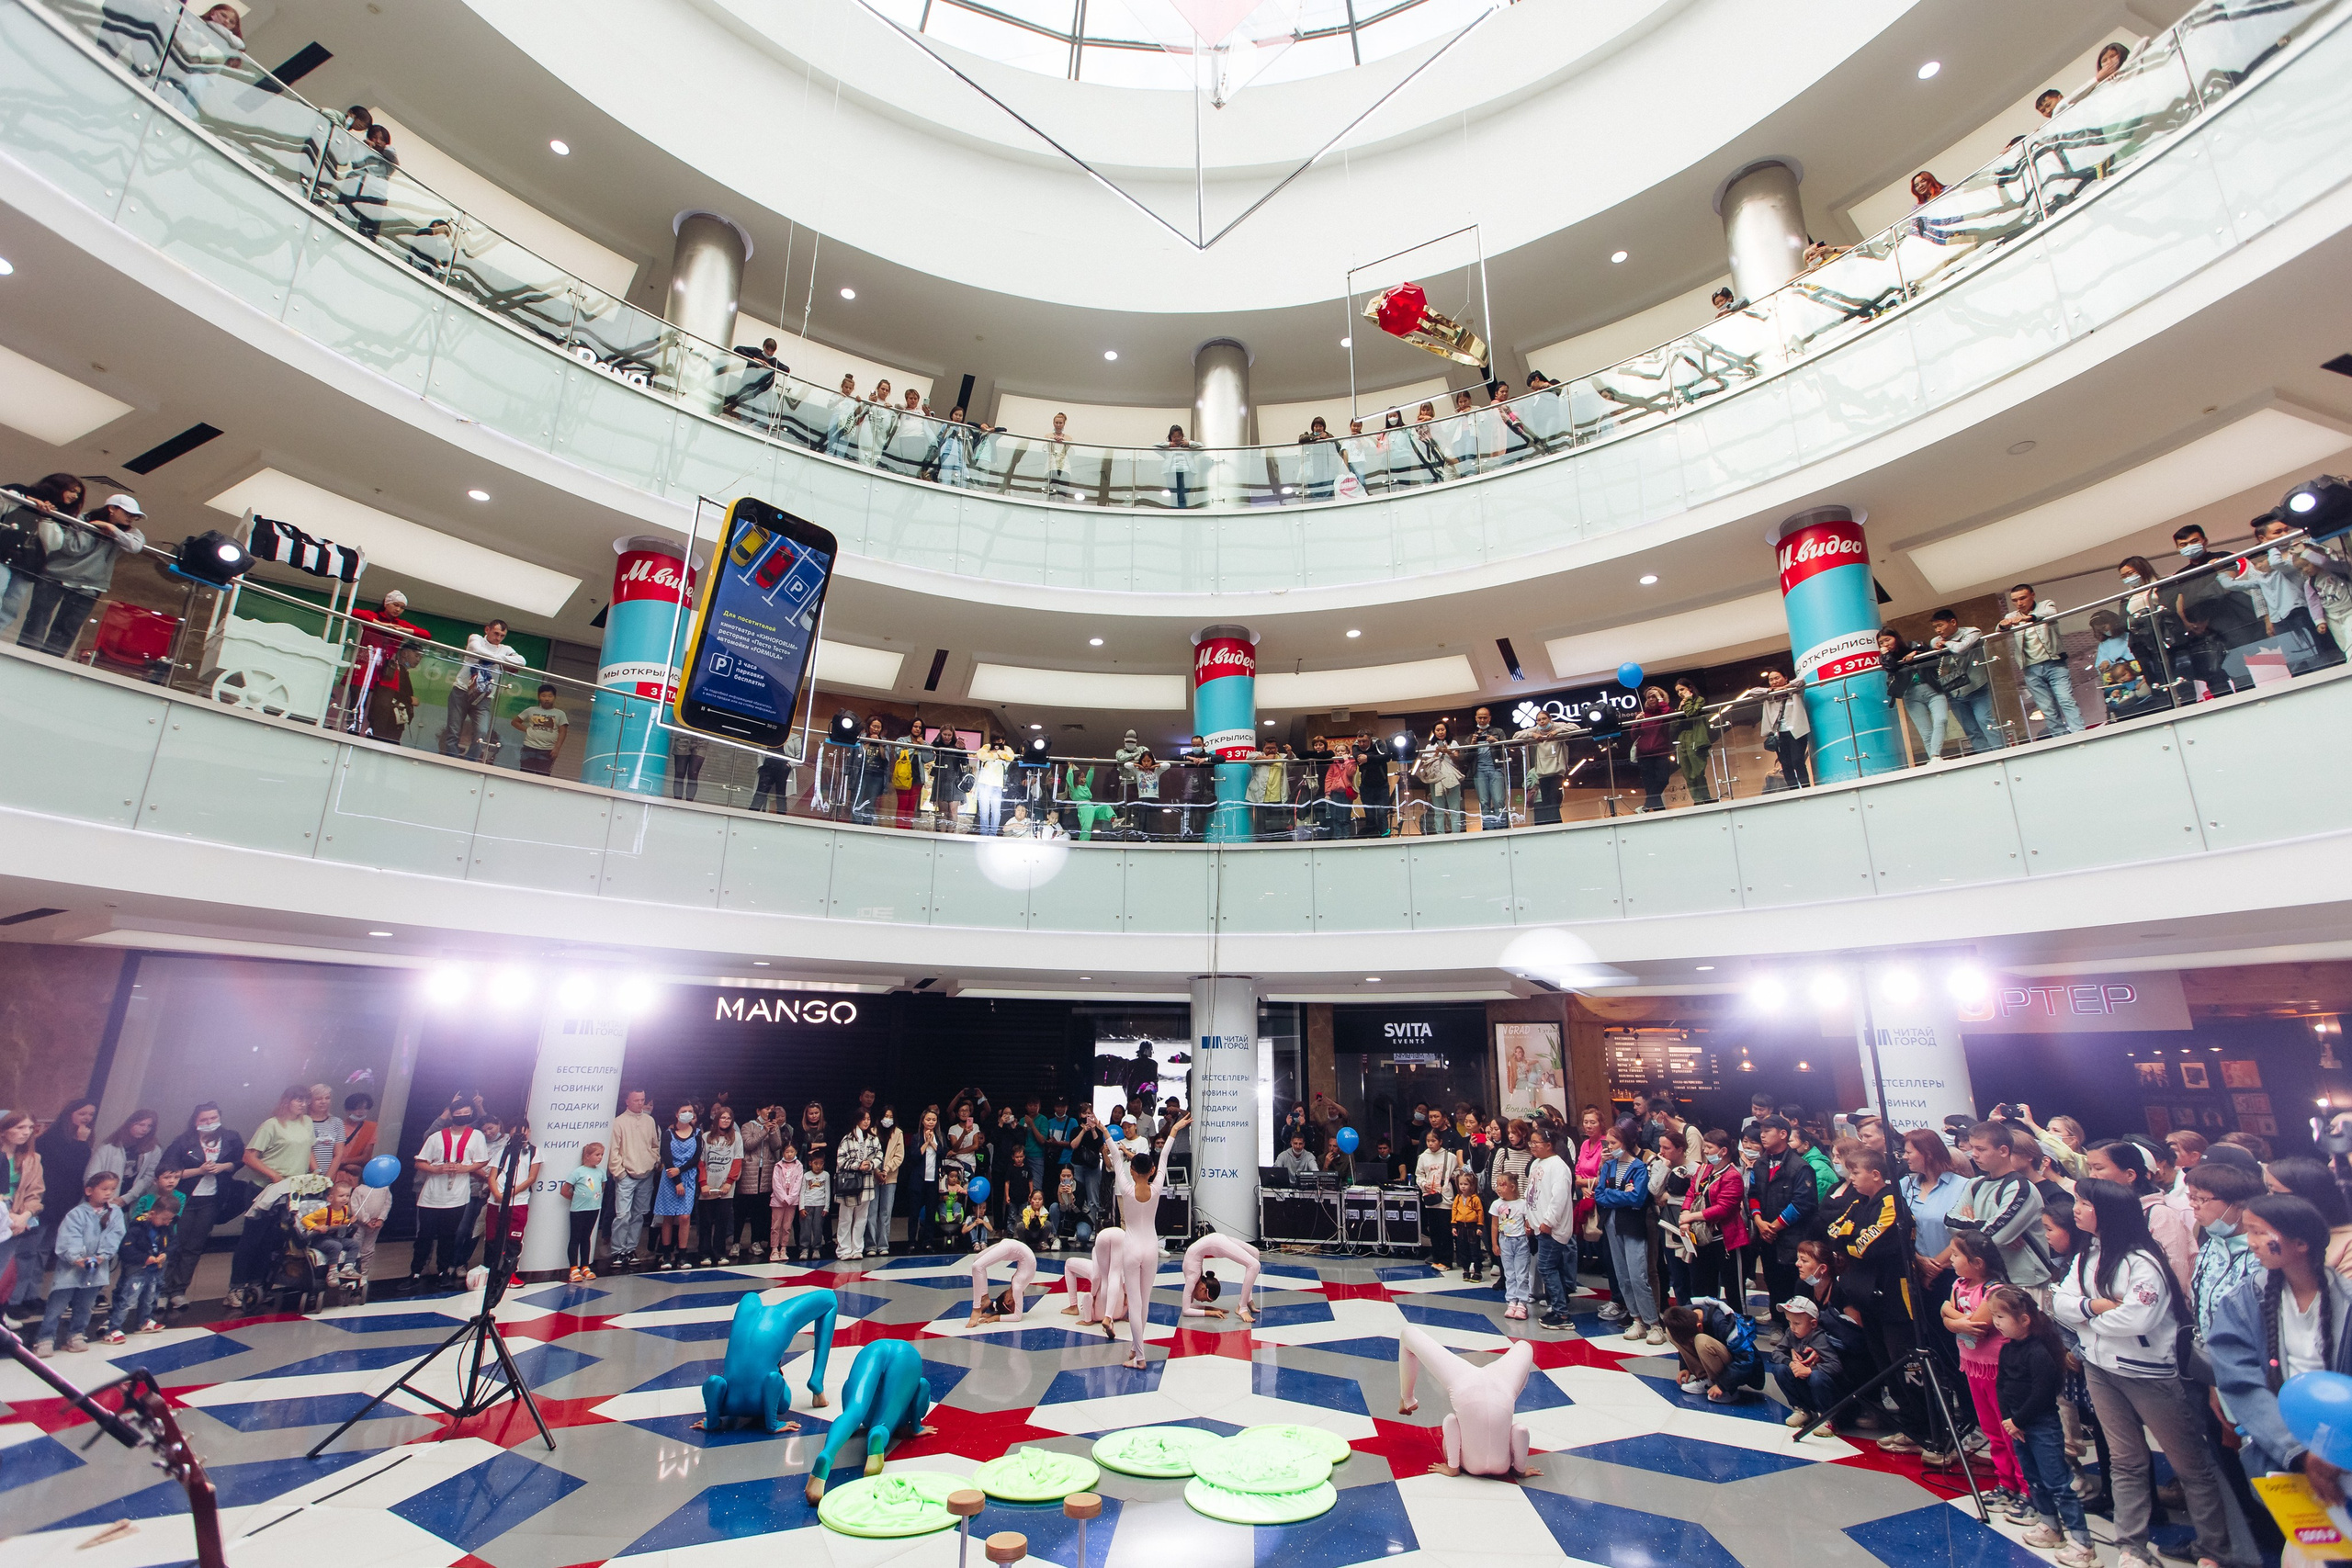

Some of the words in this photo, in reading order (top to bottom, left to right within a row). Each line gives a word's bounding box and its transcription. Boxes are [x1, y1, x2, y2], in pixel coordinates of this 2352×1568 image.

[722, 610, 736, 619] Для
[737, 615, 776, 632] посетителей
[720, 621, 755, 637] кинотеатра
[718, 628, 750, 643] ресторана
[717, 636, 750, 650] автомойки
[1802, 637, 1876, 668] ОТКРЫЛИСЬ!
[743, 662, 757, 671] часа
[1833, 664, 1842, 674] 3
[603, 669, 619, 680] МЫ
[735, 667, 764, 680] парковки
[733, 674, 766, 688] бесплатно
[650, 687, 658, 695] 3
[1542, 691, 1637, 722] Qudro
[715, 996, 857, 1025] MANGO
[1384, 1022, 1433, 1037] SVITA
[1509, 1025, 1531, 1034] GRAD
[1893, 1026, 1934, 1037] ЧИТАЙ
[1224, 1034, 1249, 1043] ЧИТАЙ
[1894, 1037, 1938, 1046] ГОРОД
[1224, 1042, 1250, 1050] ГОРОД
[556, 1066, 618, 1075] БЕСТСЕЛЛЕРЫ
[553, 1084, 604, 1092] НОВИНКИ
[1871, 1078, 1945, 1089] БСТСЕЛЛЕРЫ
[550, 1102, 600, 1111] ПОДАРКИ
[1875, 1099, 1927, 1108] НВИНКИ
[547, 1121, 609, 1131] КАНЦЕЛЯРИЯ
[1891, 1119, 1928, 1128] ДАРКИ
[1201, 1168, 1206, 1178] 3
[1208, 1168, 1238, 1179] ЭТАЖ
[536, 1181, 544, 1191] 3
[547, 1180, 565, 1191] ЭТ
